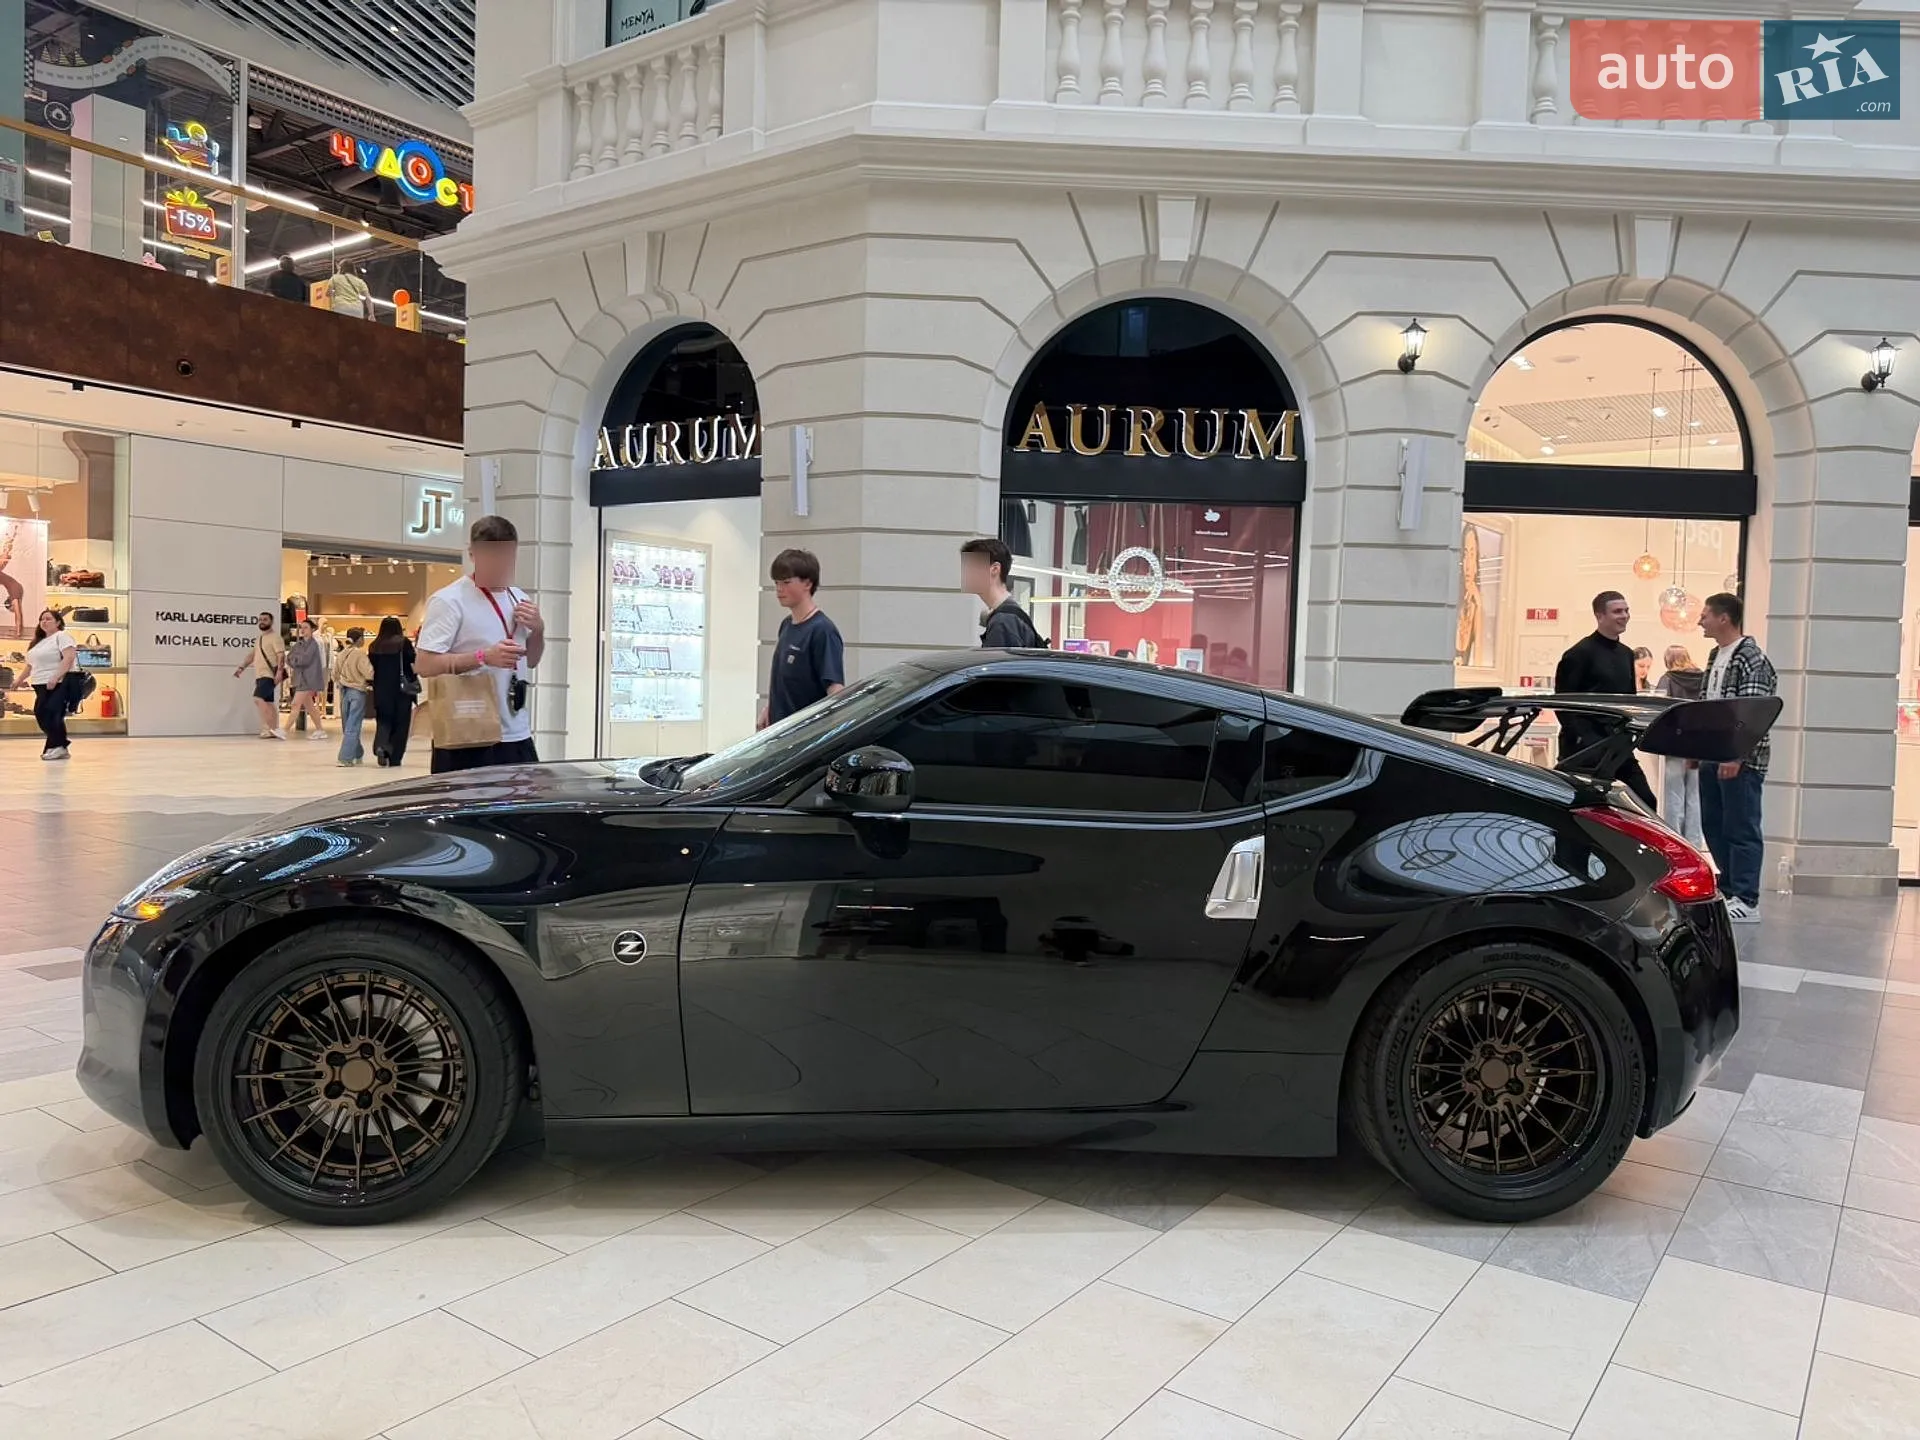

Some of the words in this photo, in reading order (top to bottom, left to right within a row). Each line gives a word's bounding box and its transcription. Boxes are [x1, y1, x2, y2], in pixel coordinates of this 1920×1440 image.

[1013, 401, 1300, 462] AURUM
[590, 412, 764, 472] AURUM
[155, 611, 188, 623] KARL
[190, 613, 259, 626] LAGERFELD
[155, 634, 218, 647] MICHAEL
[617, 941, 644, 955] Z
